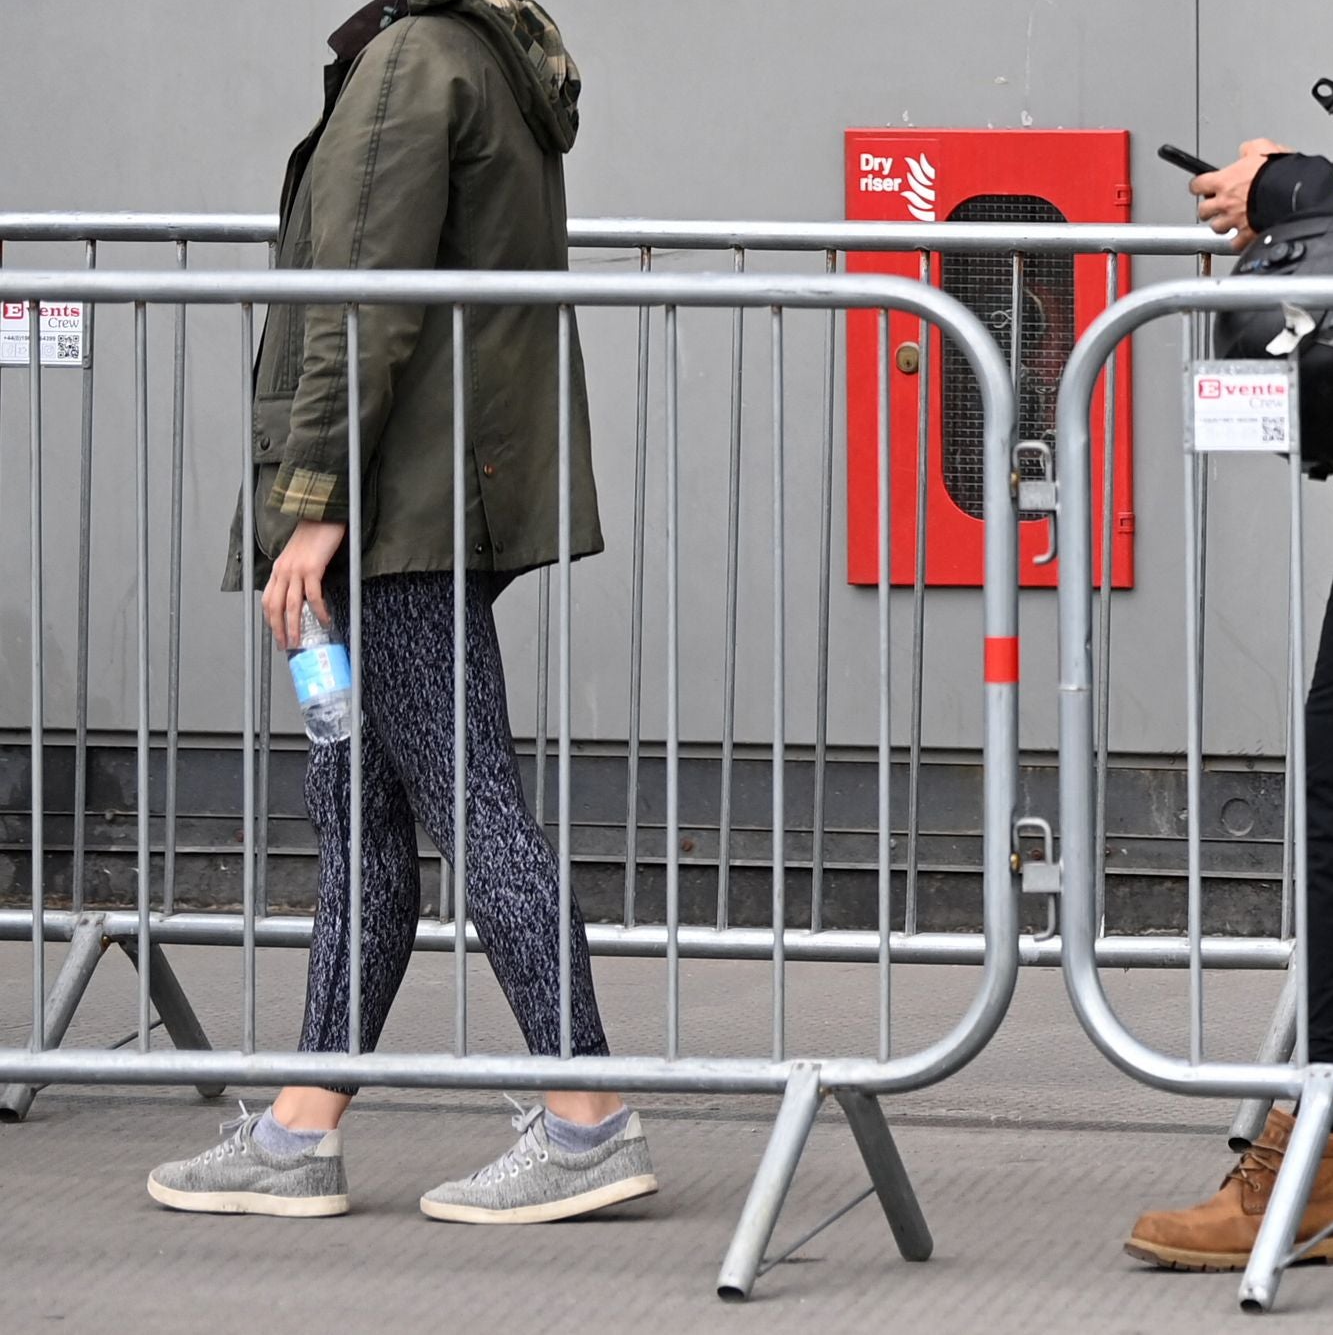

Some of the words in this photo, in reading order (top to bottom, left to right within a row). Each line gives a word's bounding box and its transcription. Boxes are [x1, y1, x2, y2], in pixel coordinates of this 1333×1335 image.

[860, 153, 893, 176] Dry
[860, 173, 902, 192] riser
[48, 317, 79, 329] Crew
[1199, 379, 1285, 399] Events
